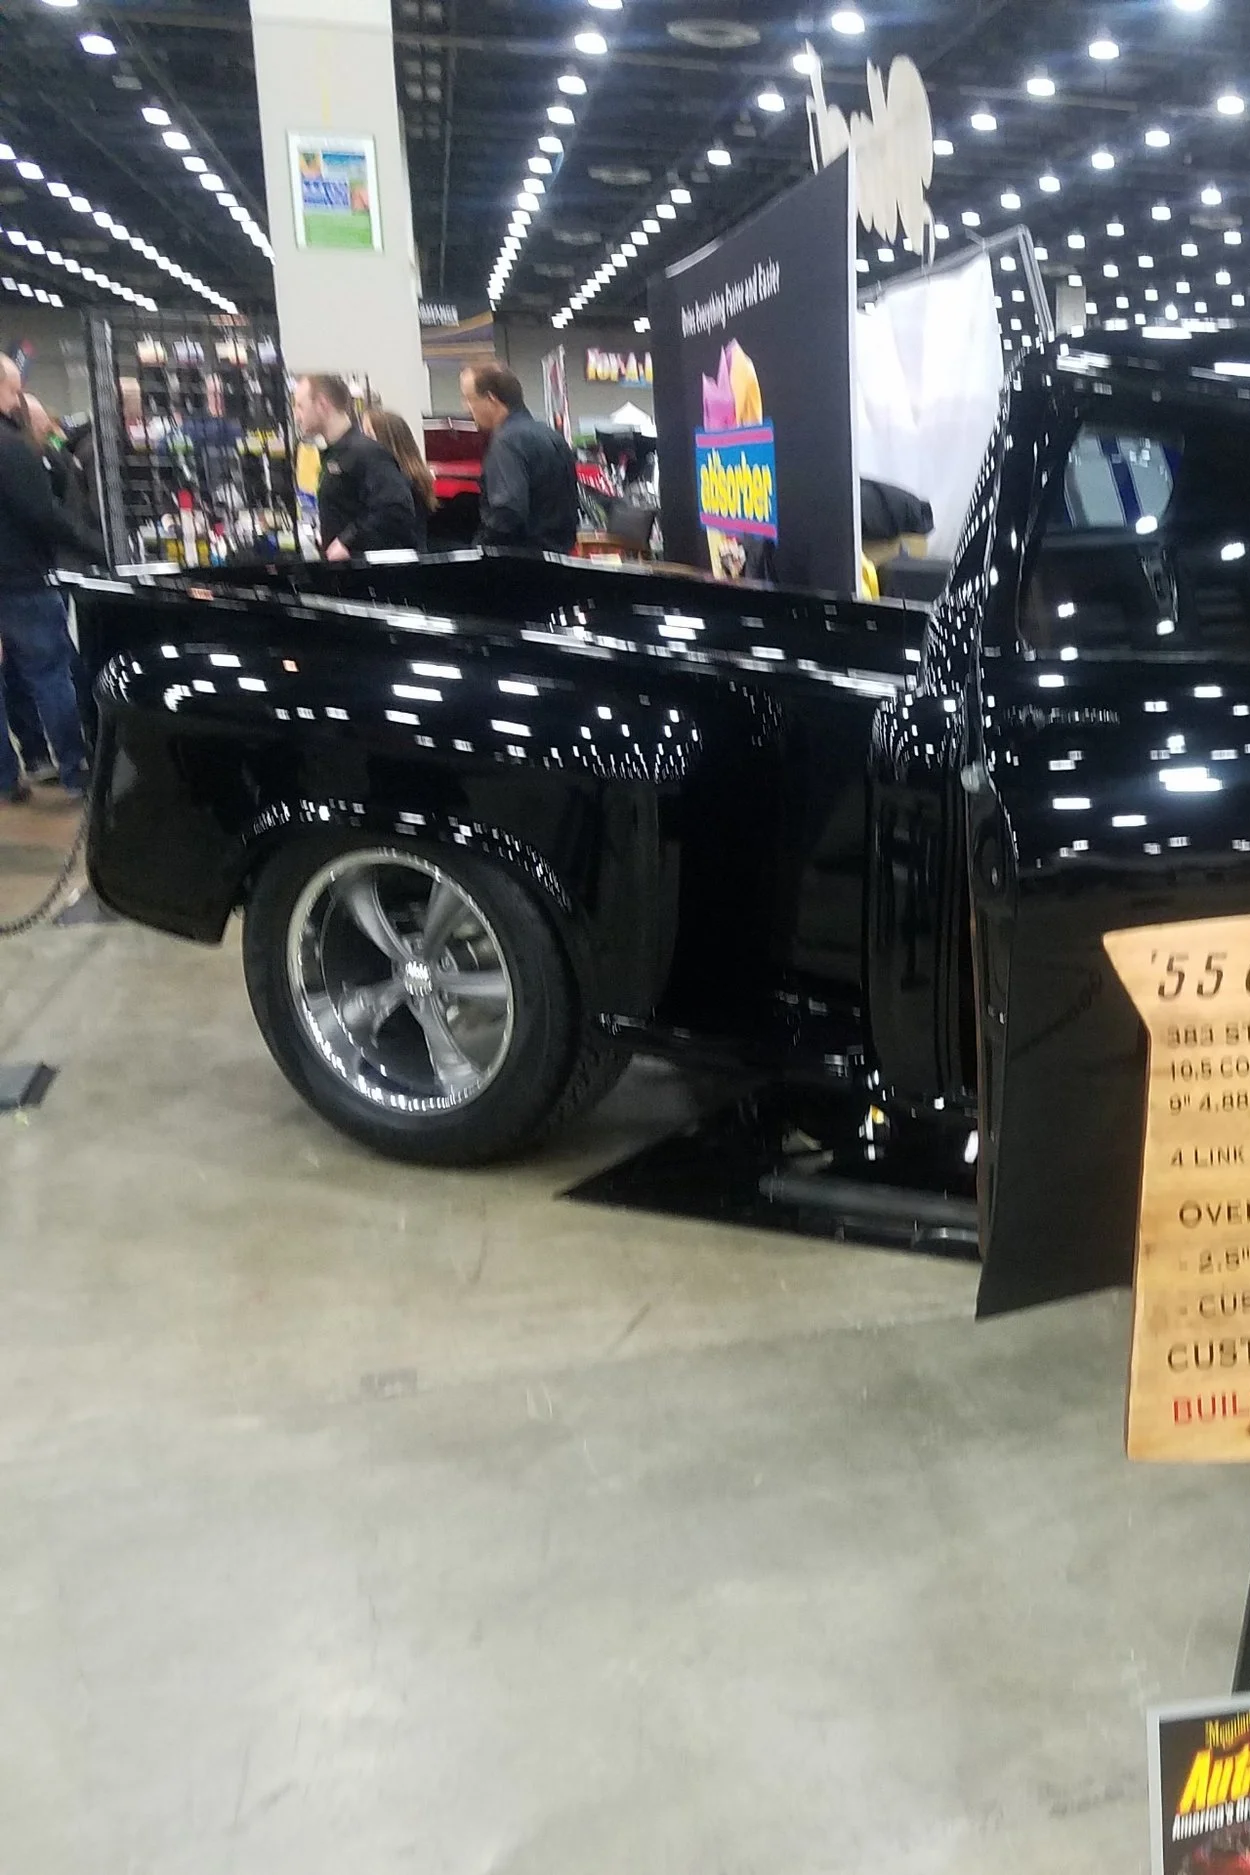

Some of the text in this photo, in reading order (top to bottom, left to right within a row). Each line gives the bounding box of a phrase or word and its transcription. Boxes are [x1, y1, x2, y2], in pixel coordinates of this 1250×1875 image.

[1150, 949, 1228, 1000] '55
[1167, 1023, 1214, 1048] 383
[1171, 1056, 1212, 1081] 10.5
[1199, 1088, 1249, 1114] 4.88
[1171, 1147, 1184, 1168] 4
[1194, 1145, 1245, 1168] LINK
